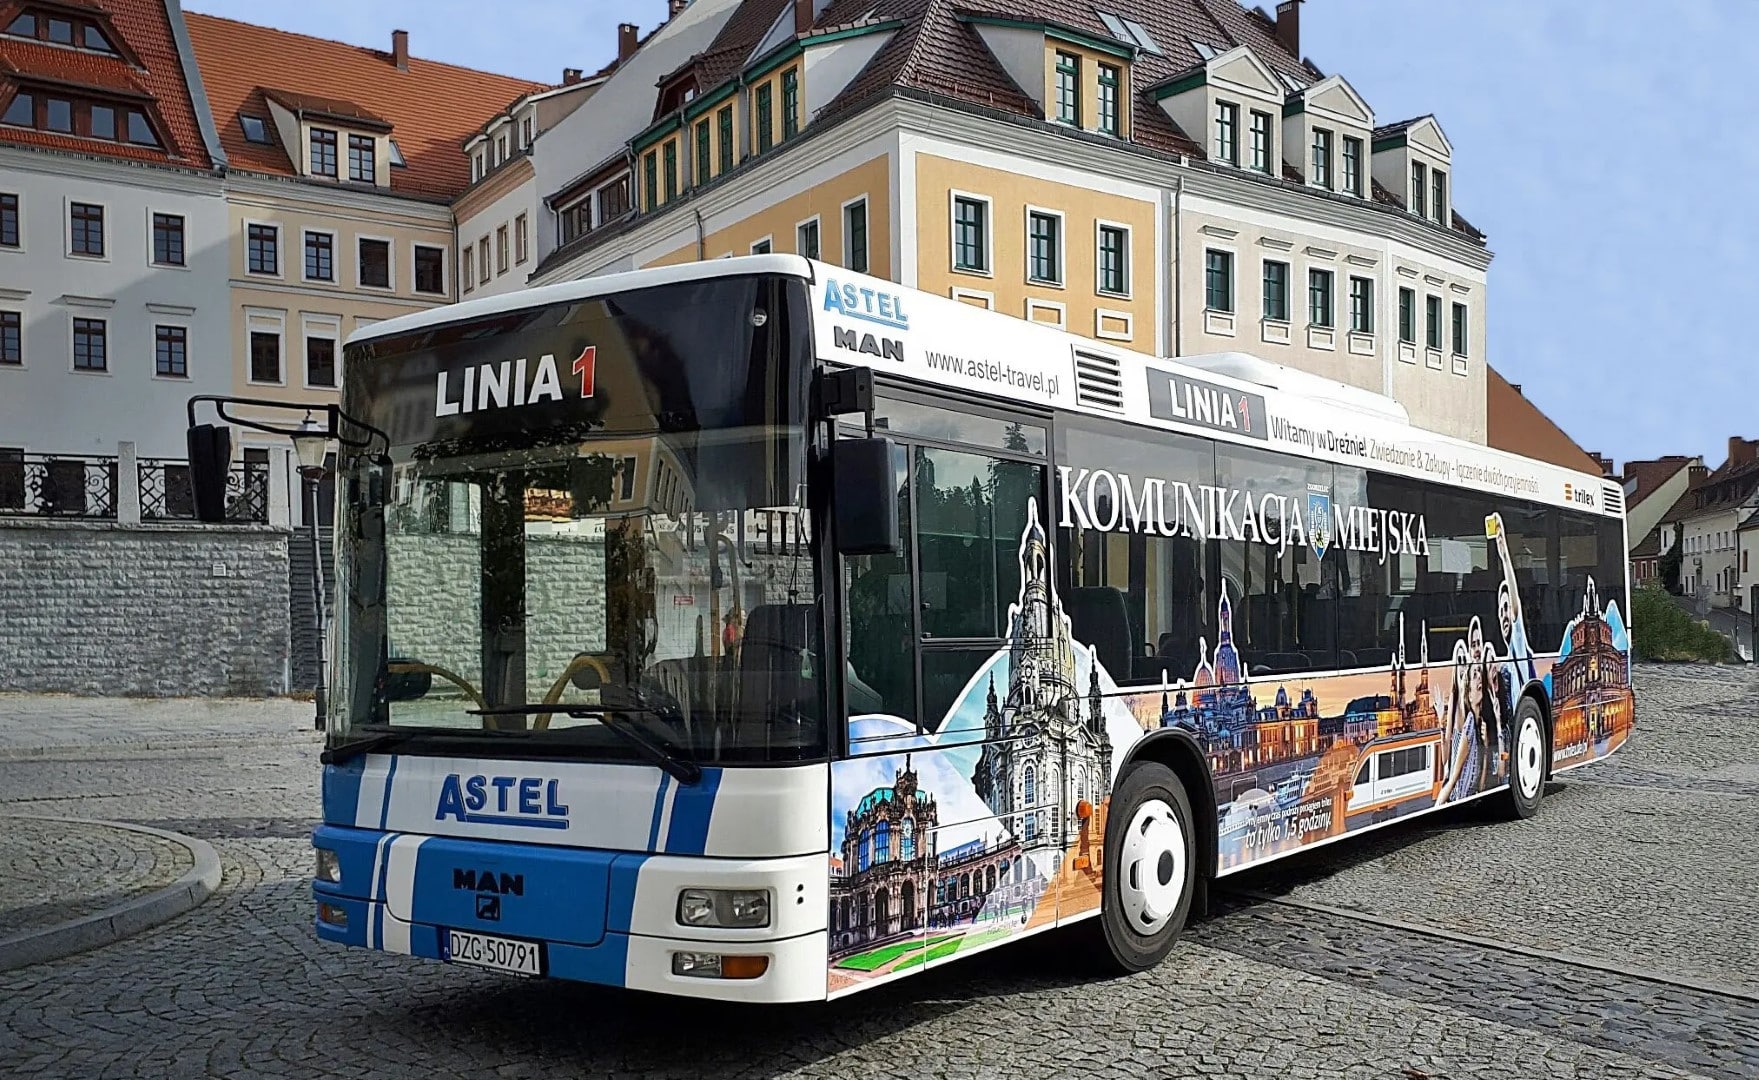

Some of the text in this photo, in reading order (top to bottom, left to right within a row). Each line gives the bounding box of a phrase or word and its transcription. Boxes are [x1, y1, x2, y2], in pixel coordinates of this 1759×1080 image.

[823, 278, 909, 322] ASTEL
[833, 326, 904, 362] MAN
[435, 344, 597, 417] LINIA 1
[925, 350, 1060, 398] www.astel-travel.pl
[1168, 378, 1252, 433] LINIA 1
[1271, 415, 1315, 453] Witamy
[1317, 431, 1326, 449] w
[1416, 449, 1423, 469] &
[1058, 465, 1430, 565] KOMUNIKACJA MIEJSKA
[1574, 488, 1595, 507] trilex
[435, 774, 569, 822] ASTEL
[1245, 809, 1332, 850] to tylko 1,5 godziny.
[454, 868, 524, 896] MAN
[451, 933, 536, 971] DZG 50791
